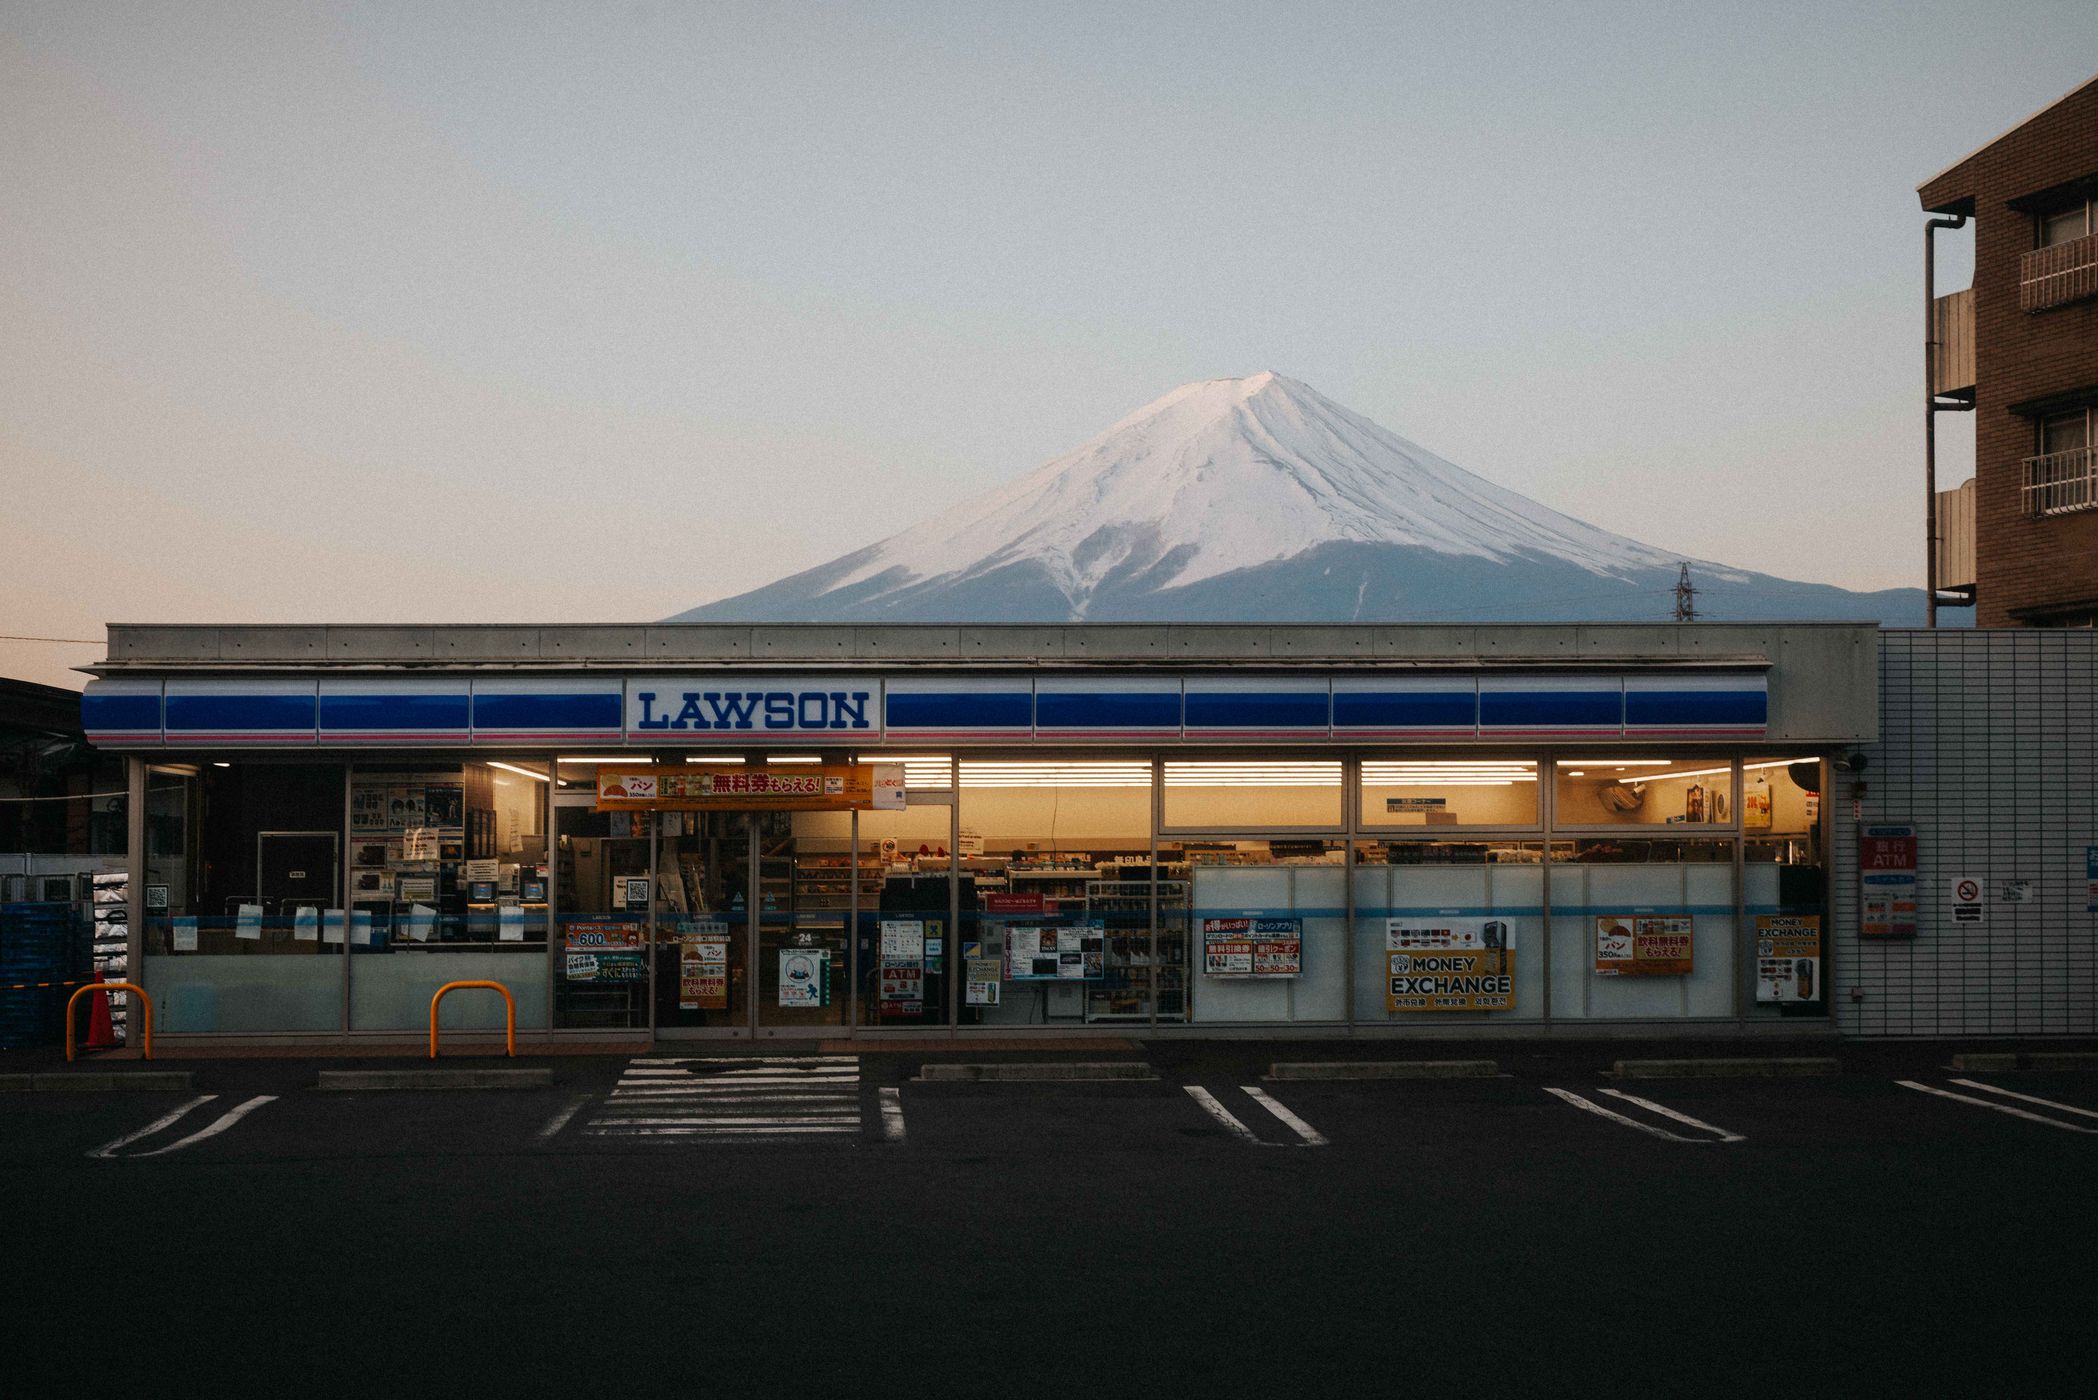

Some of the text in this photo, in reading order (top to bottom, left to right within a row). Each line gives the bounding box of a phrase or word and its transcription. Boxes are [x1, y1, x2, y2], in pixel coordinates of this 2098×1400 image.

[638, 692, 870, 729] LAWSON
[1873, 853, 1907, 867] ATM
[1257, 921, 1293, 931] ローソンアプリ
[1771, 919, 1803, 927] MONEY
[799, 933, 812, 942] 24
[1758, 928, 1817, 937] EXCHANGE
[1605, 942, 1626, 951] パン
[1412, 957, 1476, 972] MONEY
[888, 969, 916, 979] ATM
[1391, 977, 1511, 994] EXCHANGE
